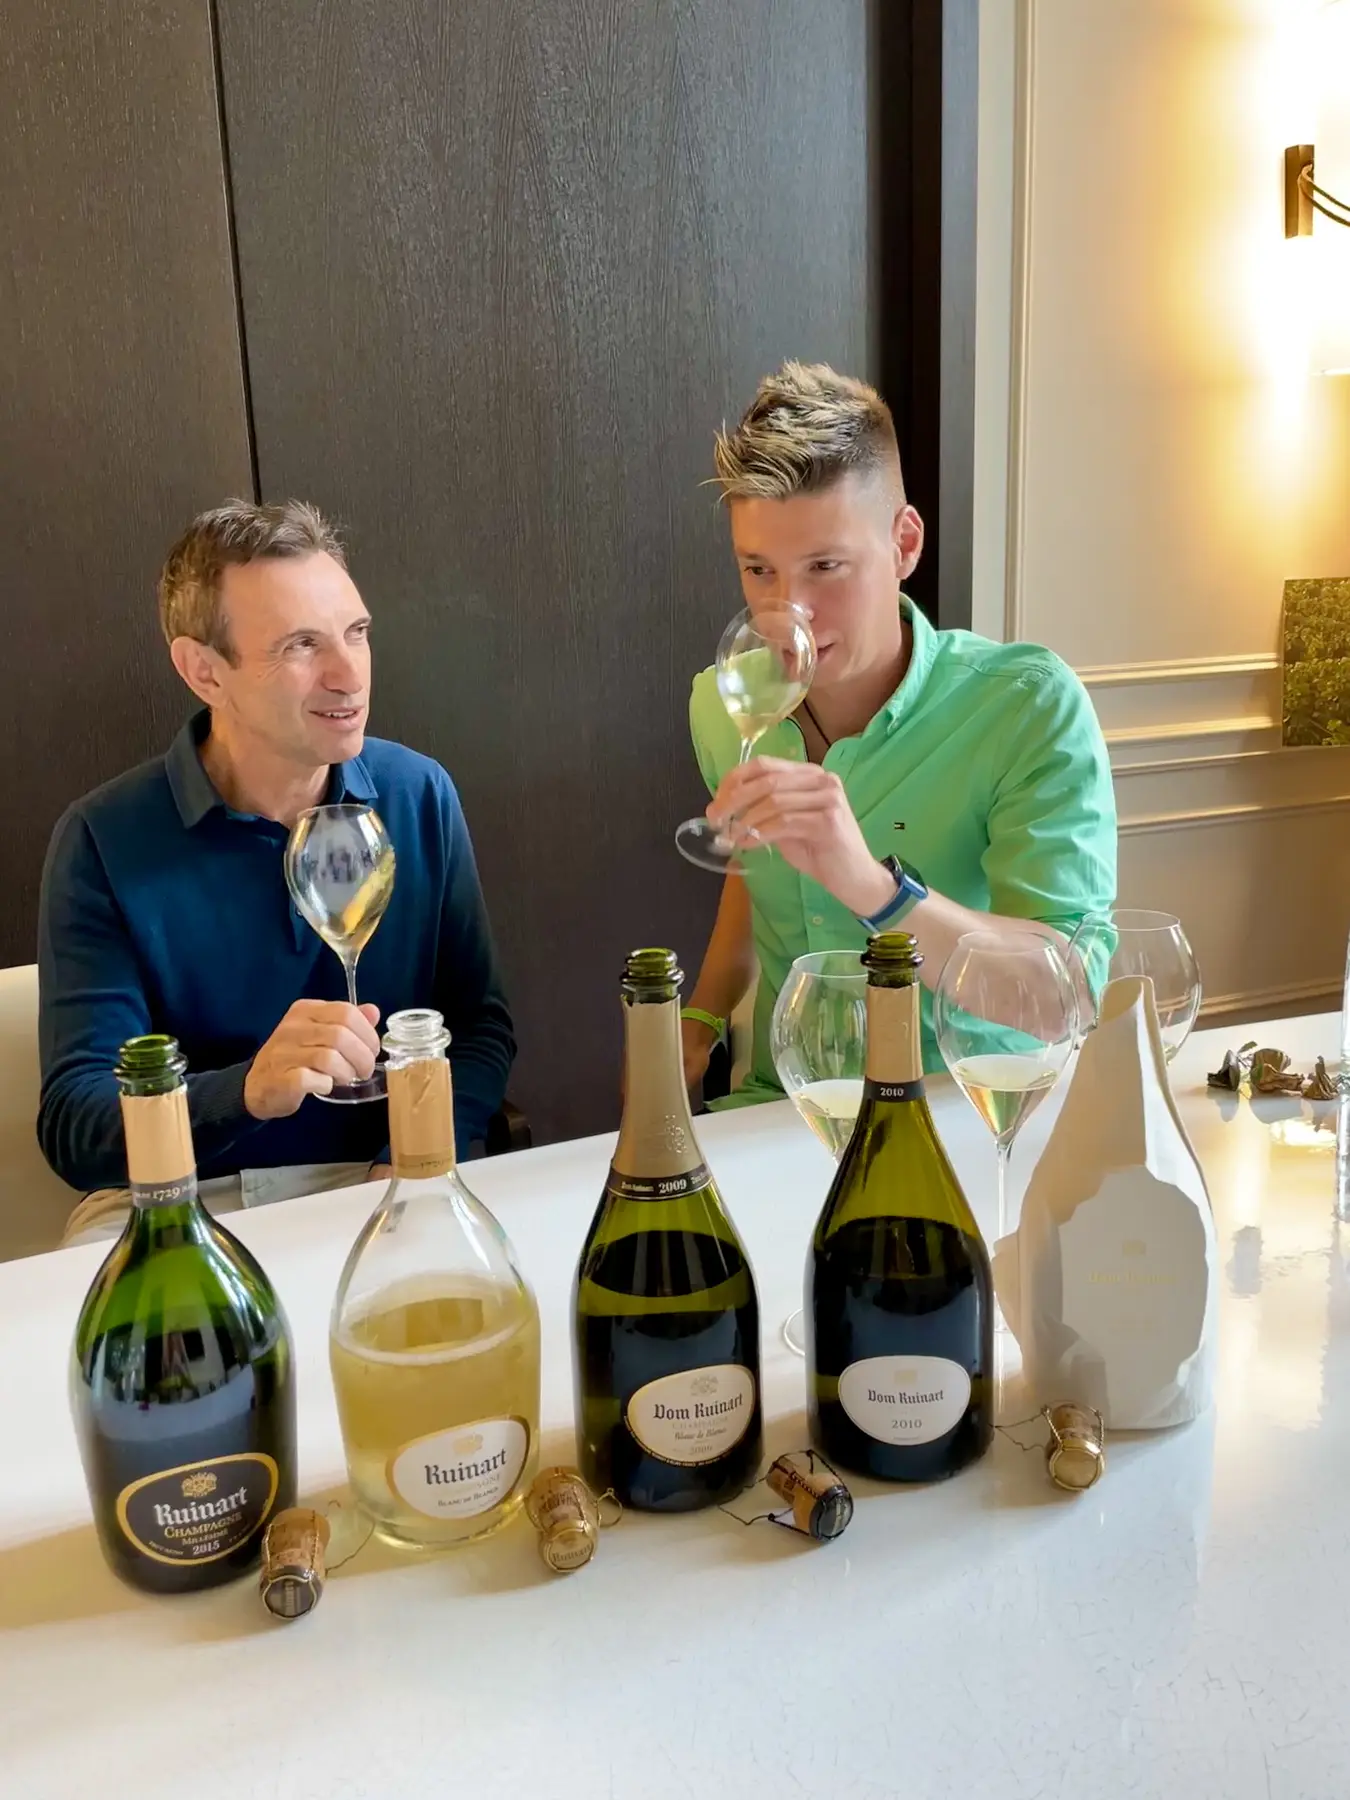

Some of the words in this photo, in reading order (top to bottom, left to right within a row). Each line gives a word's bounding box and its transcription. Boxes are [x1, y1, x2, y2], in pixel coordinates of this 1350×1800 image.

[880, 1087, 904, 1097] 2010
[658, 1179, 687, 1193] 2009
[152, 1187, 180, 1202] 1729
[868, 1389, 896, 1404] Dom
[899, 1390, 944, 1404] Ruinart
[653, 1404, 690, 1420] Dom
[695, 1393, 743, 1418] Ruinart
[891, 1419, 922, 1429] 2010
[424, 1448, 507, 1486] Ruinart
[154, 1486, 248, 1527] Ruinart
[164, 1512, 243, 1539] CHAMPAGNE
[192, 1540, 221, 1556] 2015
